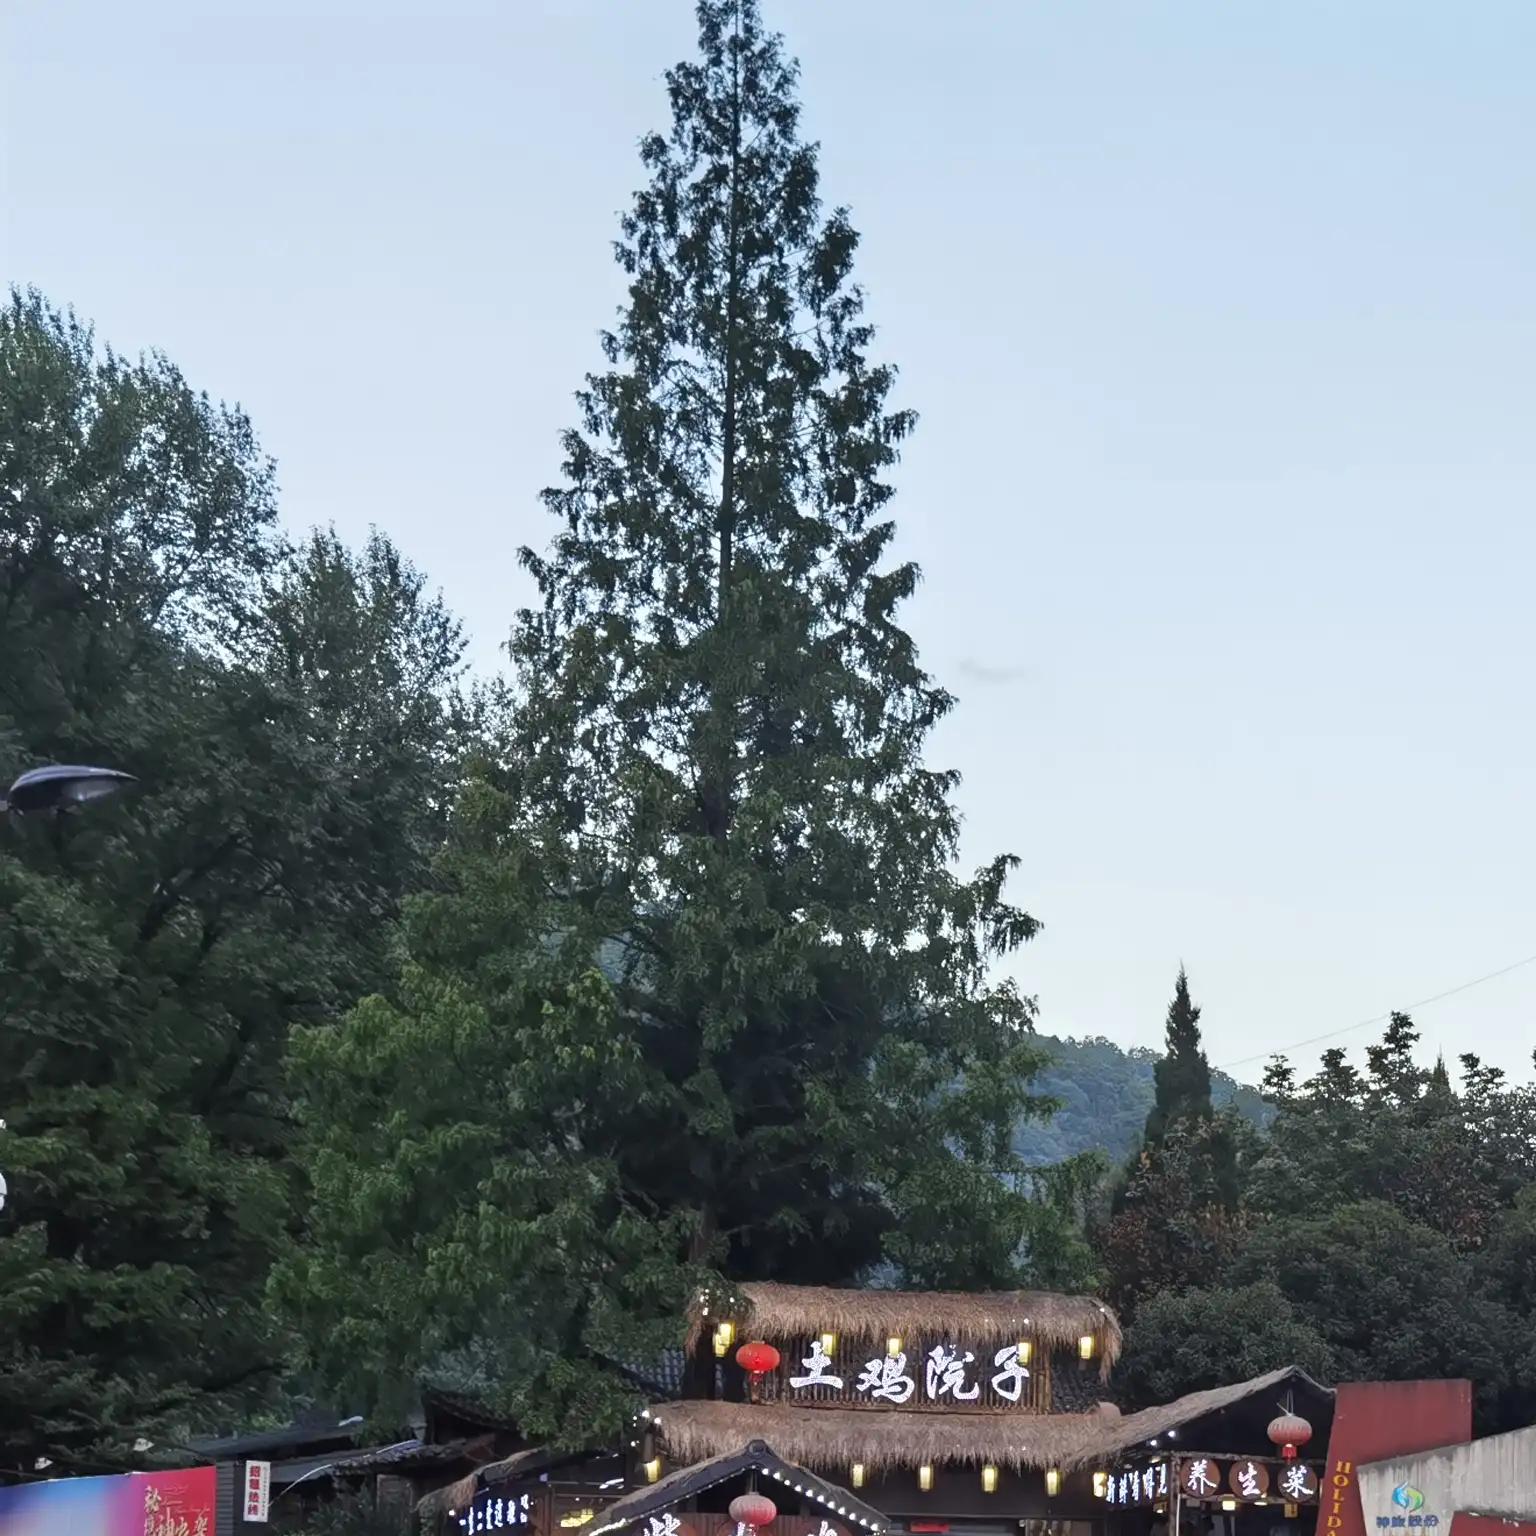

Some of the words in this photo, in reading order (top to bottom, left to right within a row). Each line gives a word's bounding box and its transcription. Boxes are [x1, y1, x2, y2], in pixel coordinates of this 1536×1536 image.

[789, 1341, 1031, 1403] 土鸡院子
[1186, 1459, 1318, 1498] 养生菜
